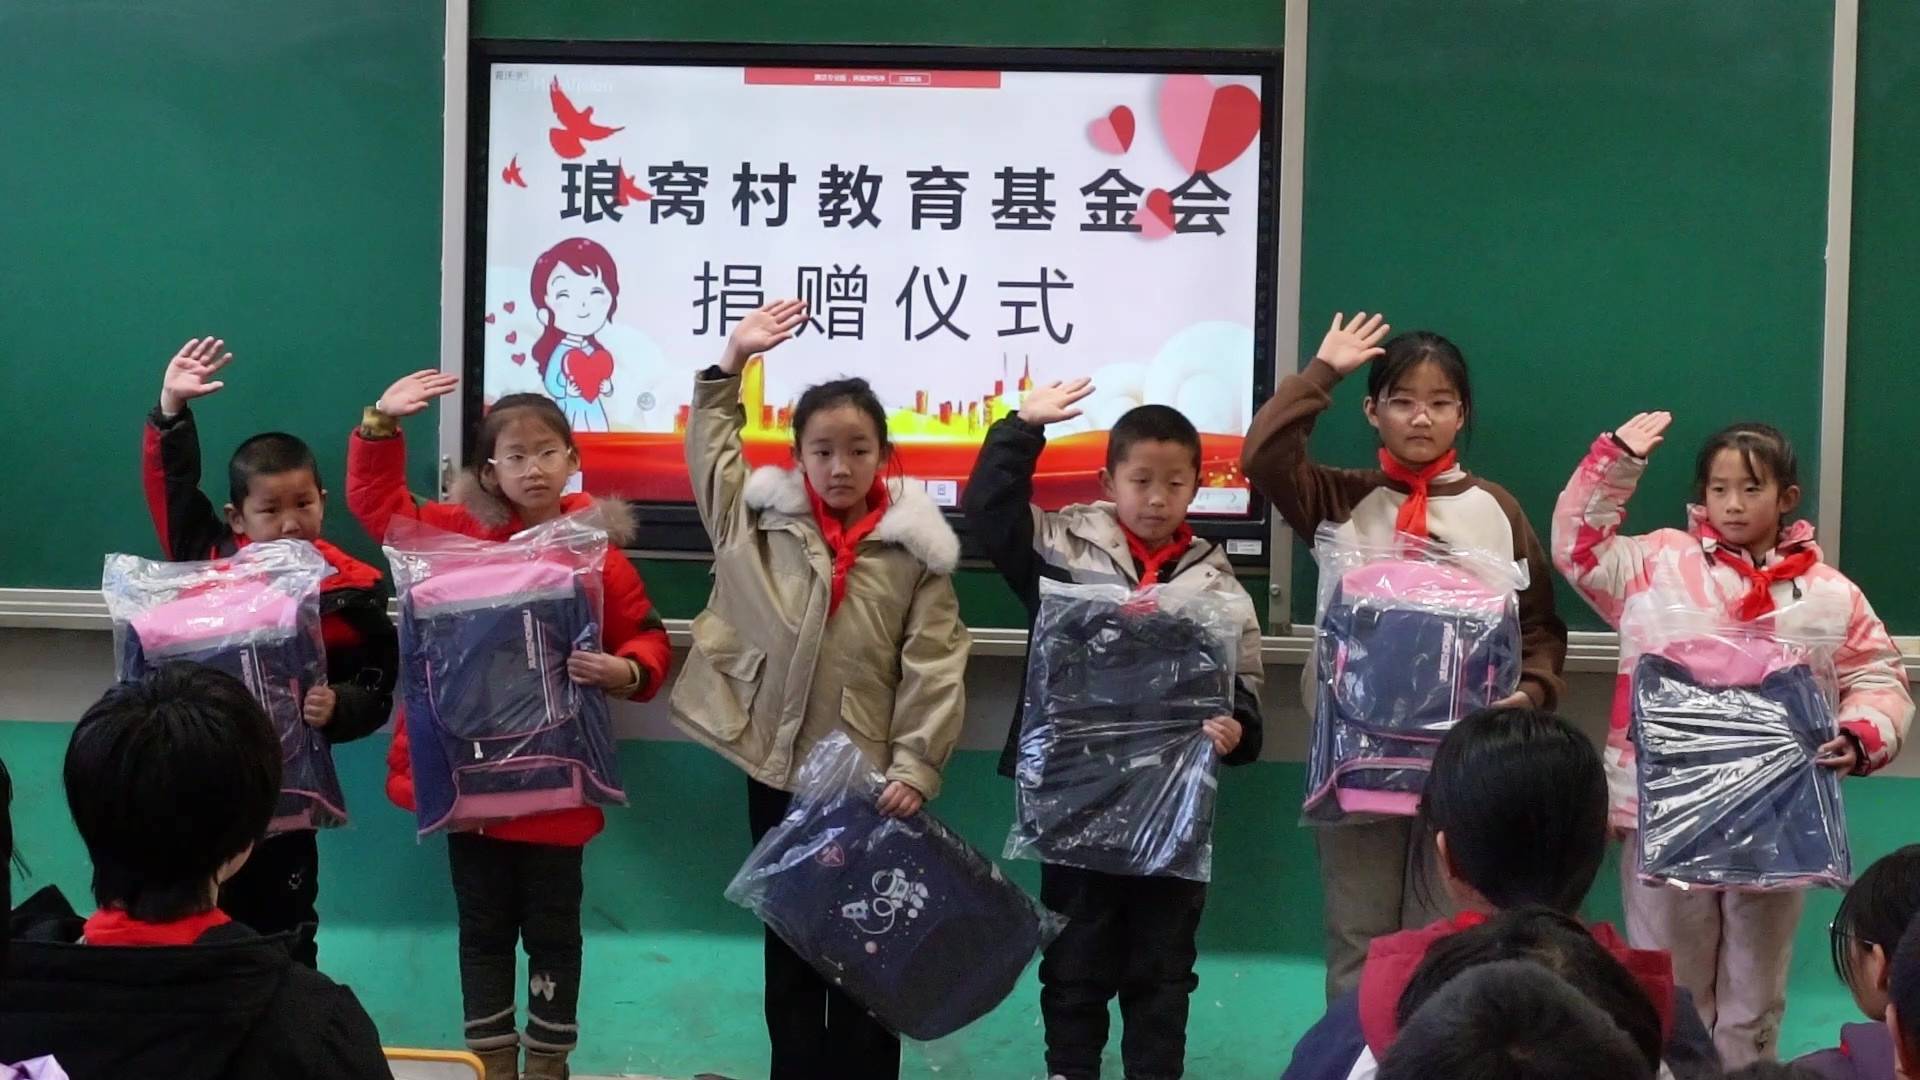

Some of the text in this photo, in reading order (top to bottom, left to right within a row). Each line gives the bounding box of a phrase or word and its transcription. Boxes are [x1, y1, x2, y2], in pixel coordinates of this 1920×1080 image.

[560, 159, 1232, 236] 琅窝村教育基金会
[692, 260, 1074, 344] 捐赠仪式
